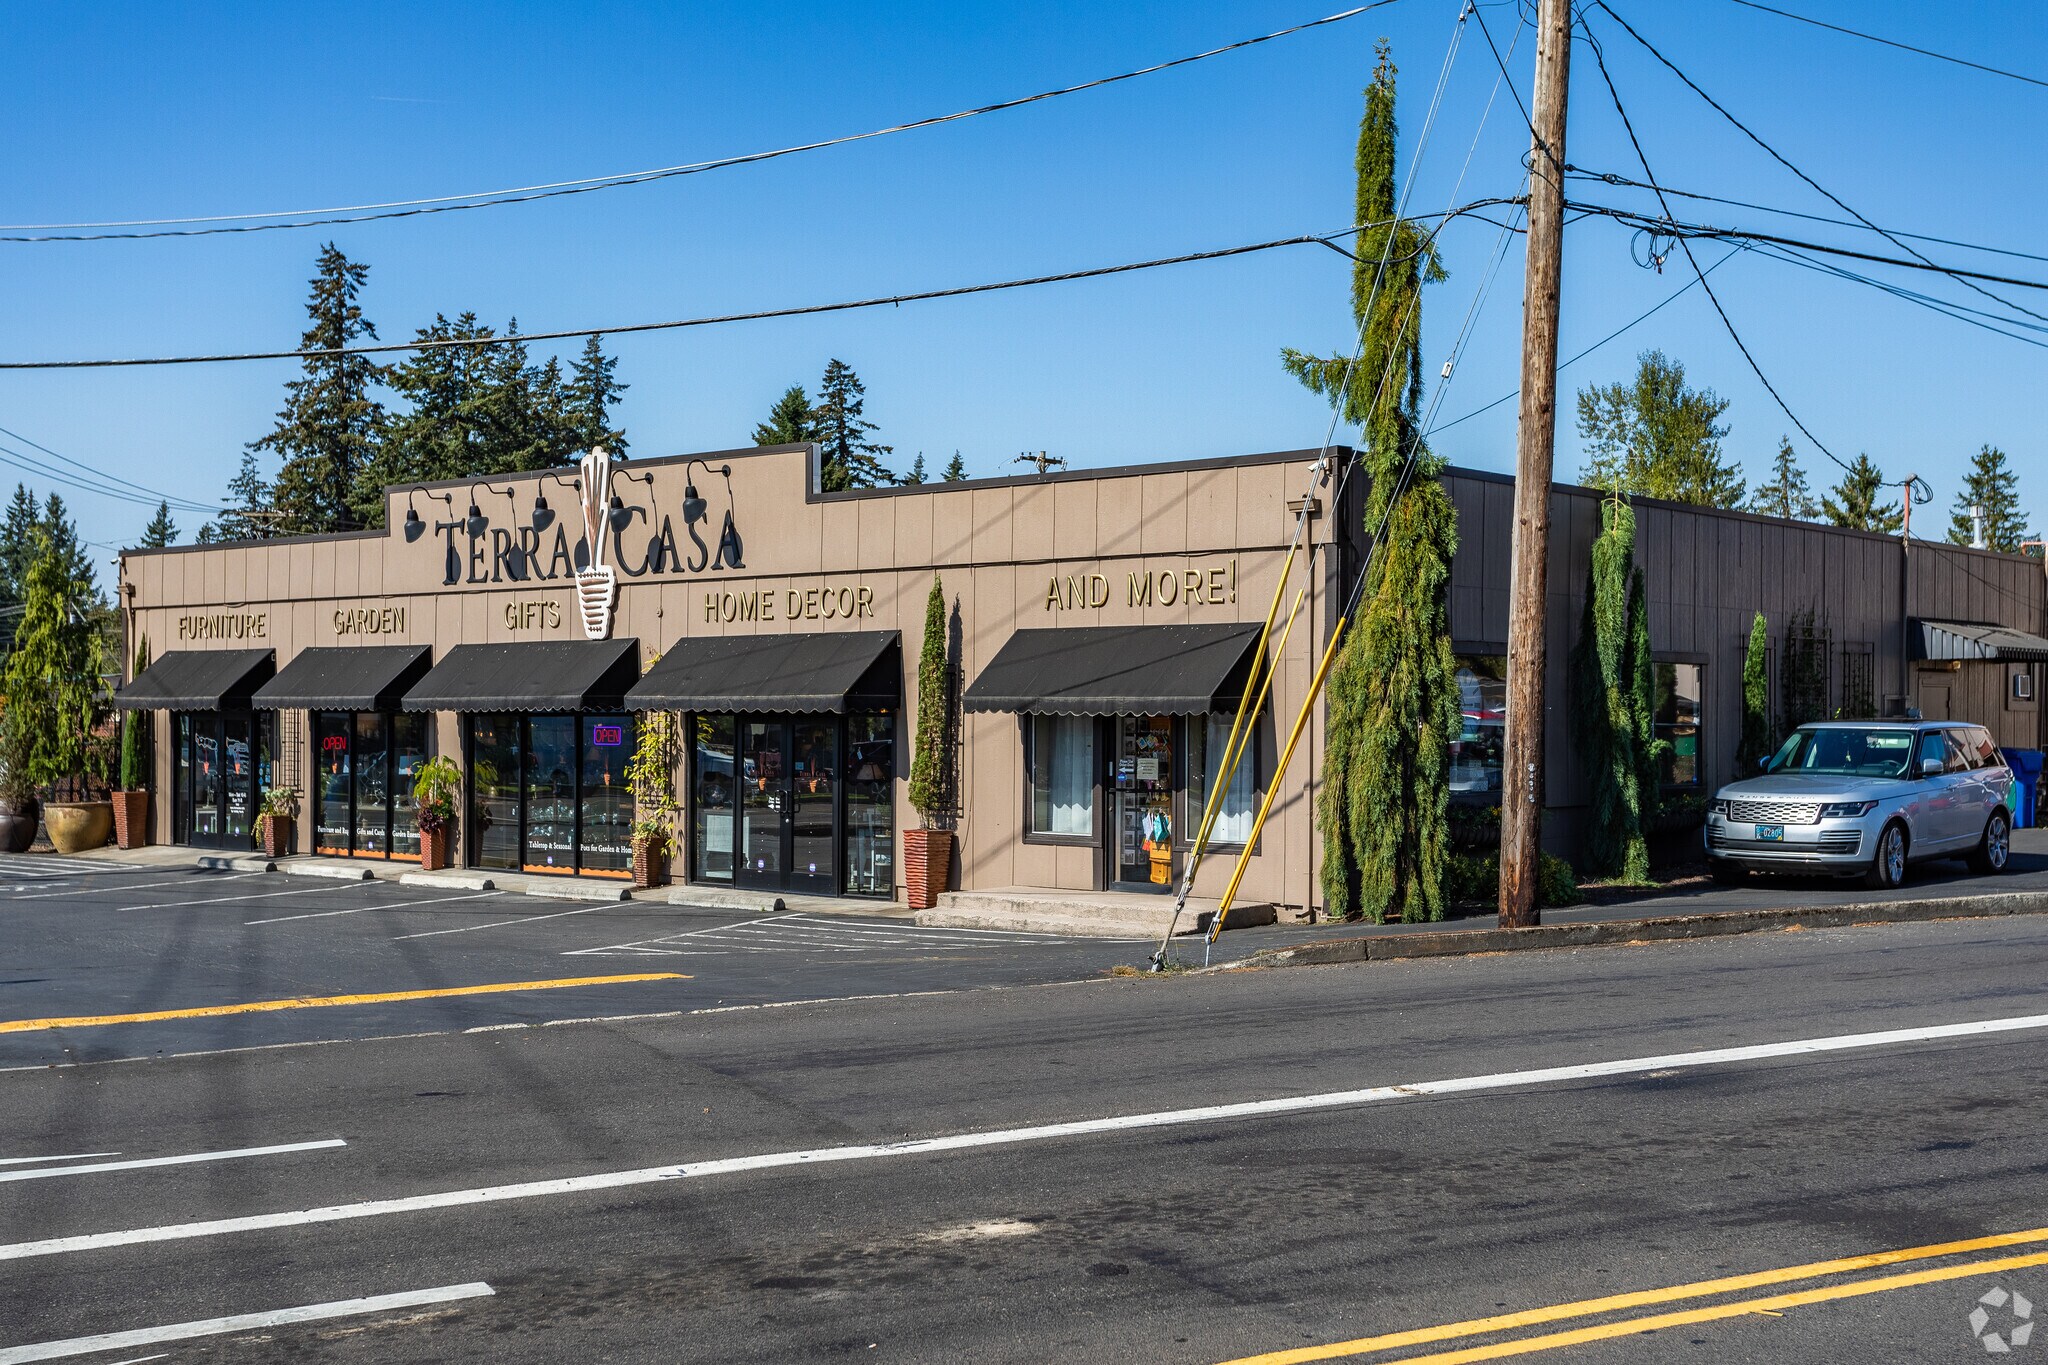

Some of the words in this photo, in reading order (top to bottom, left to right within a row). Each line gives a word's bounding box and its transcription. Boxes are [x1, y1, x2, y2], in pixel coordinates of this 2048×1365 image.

[435, 518, 575, 586] TERRA
[613, 504, 747, 577] CASA
[1045, 573, 1110, 611] AND
[1127, 559, 1236, 608] MORE!
[504, 600, 561, 631] GIFTS
[704, 590, 775, 623] HOME
[786, 585, 874, 620] DECOR
[178, 611, 267, 640] FURNITURE
[332, 606, 405, 636] GARDEN
[323, 736, 347, 750] OPEN
[595, 729, 619, 743] OPEN
[528, 840, 548, 851] Tabletop
[553, 842, 572, 850] Seasonal
[598, 844, 614, 853] Garden
[620, 845, 633, 854] Hom
